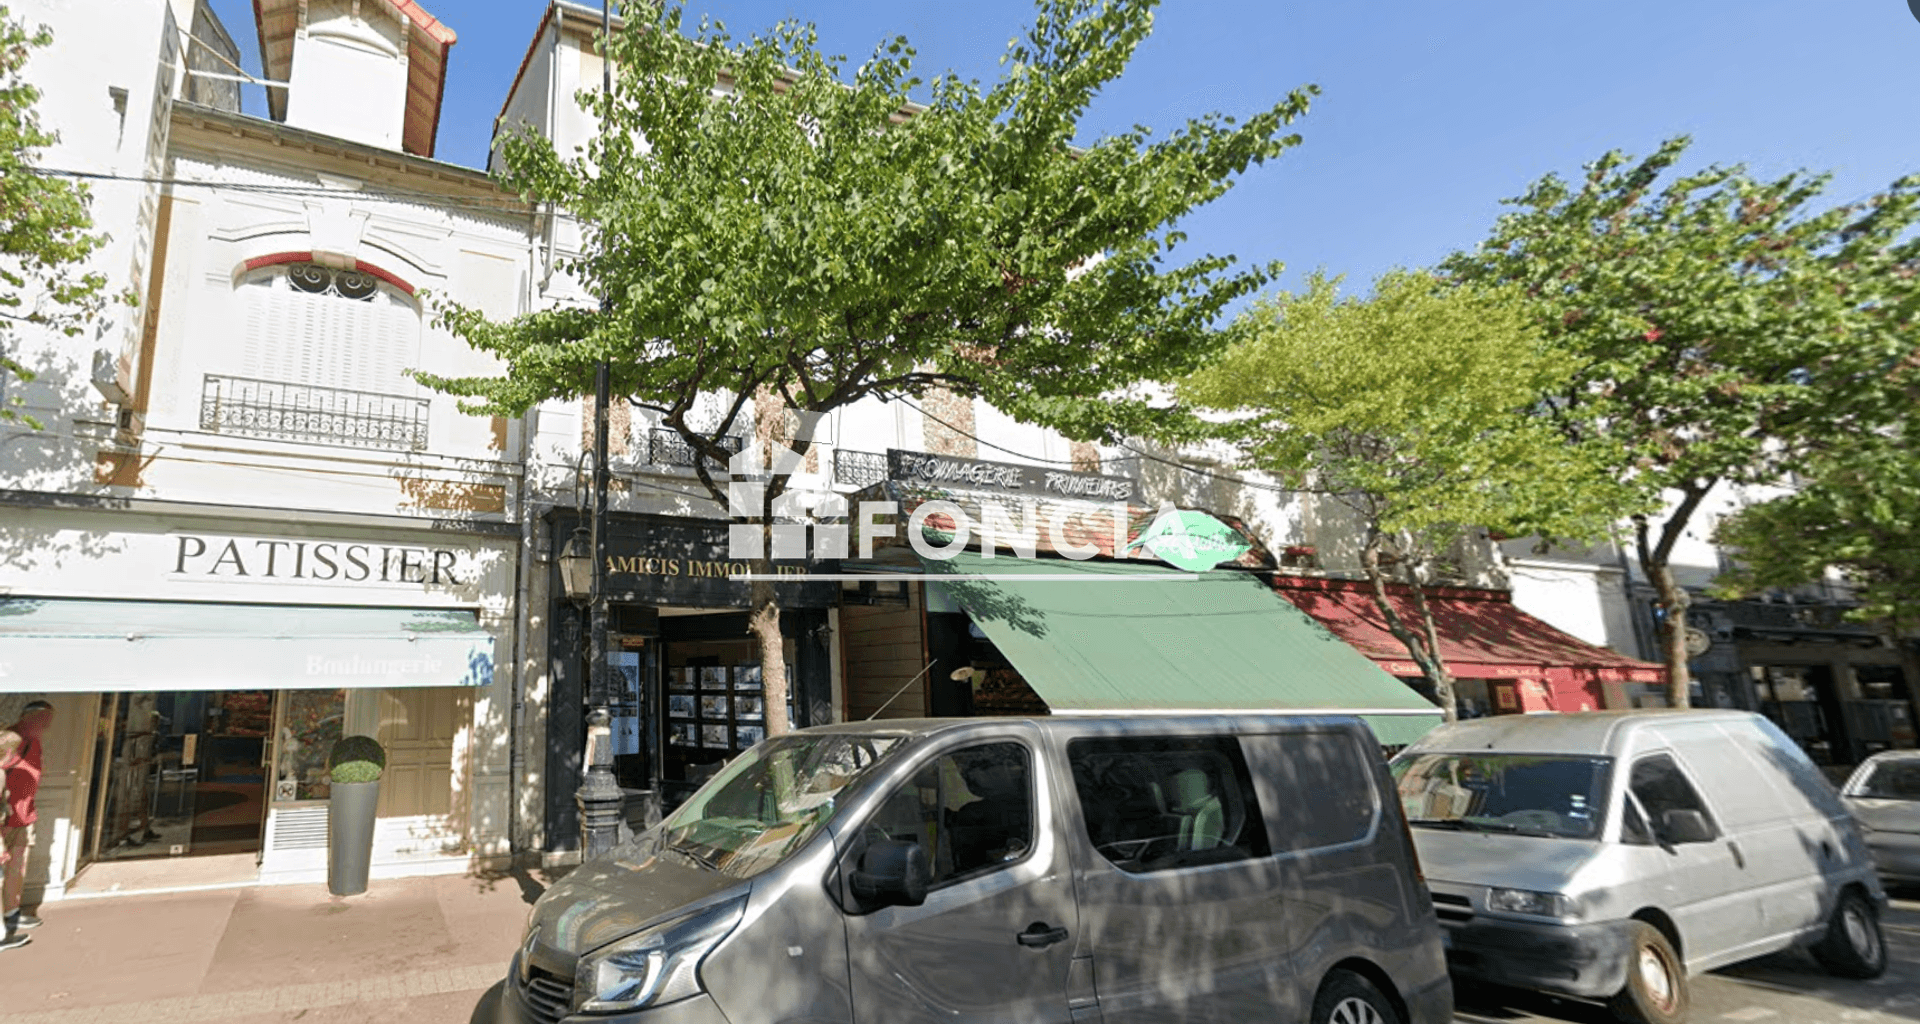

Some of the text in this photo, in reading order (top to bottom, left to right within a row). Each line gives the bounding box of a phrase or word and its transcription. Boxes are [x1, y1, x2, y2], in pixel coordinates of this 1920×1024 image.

[900, 453, 1024, 489] FROMAGERIE
[1044, 472, 1134, 500] PRIMEURS
[171, 535, 464, 586] PATISSIER
[605, 555, 809, 582] AMICIS IMMOIER
